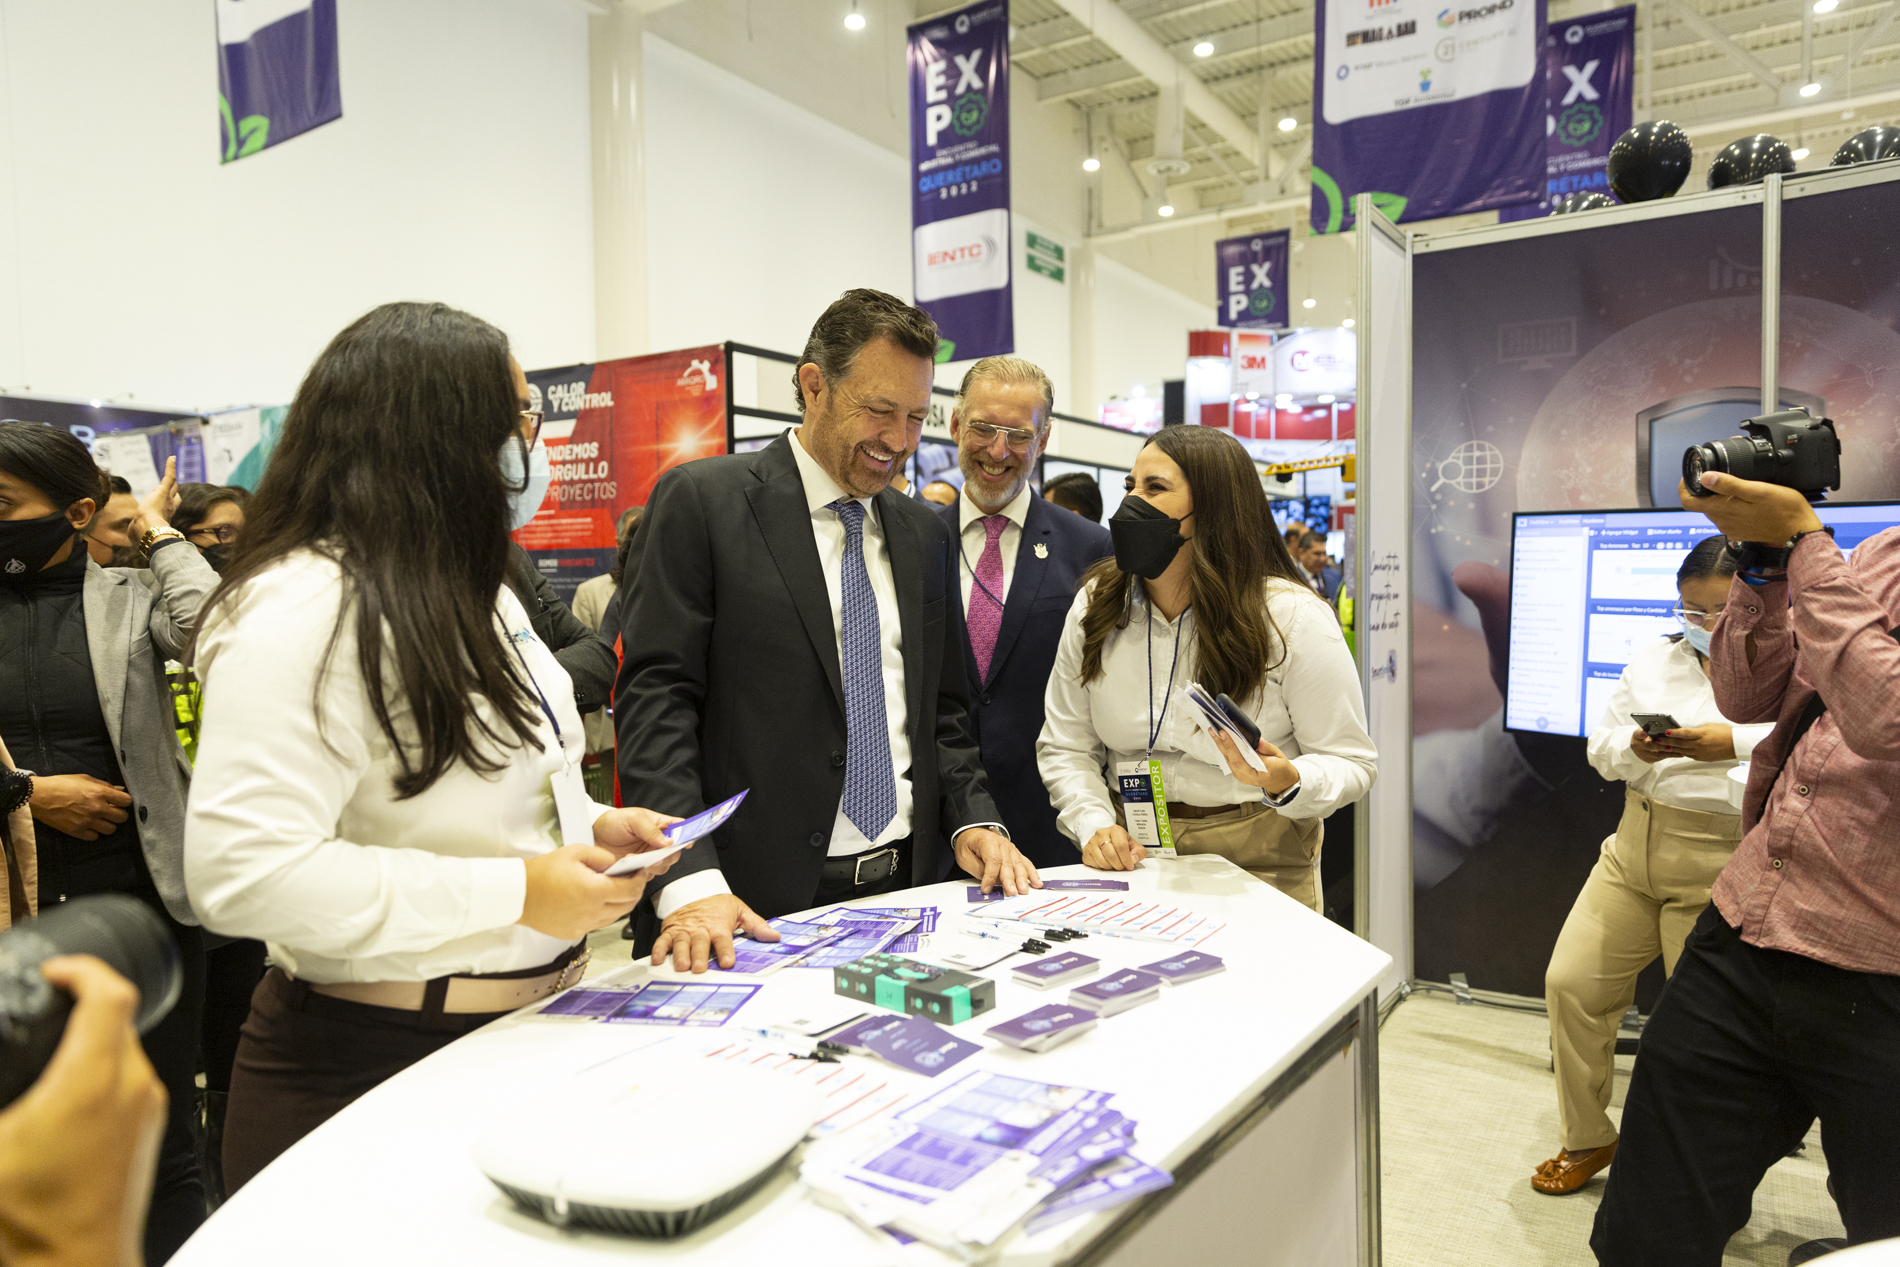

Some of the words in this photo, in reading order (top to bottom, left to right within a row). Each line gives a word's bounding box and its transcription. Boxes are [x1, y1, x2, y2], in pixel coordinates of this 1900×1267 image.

[1240, 355, 1266, 371] 3M
[547, 381, 586, 401] CALOR
[561, 391, 614, 412] CONTROL
[545, 442, 599, 462] NDEMOS
[1151, 765, 1171, 844] EXPOSITOR
